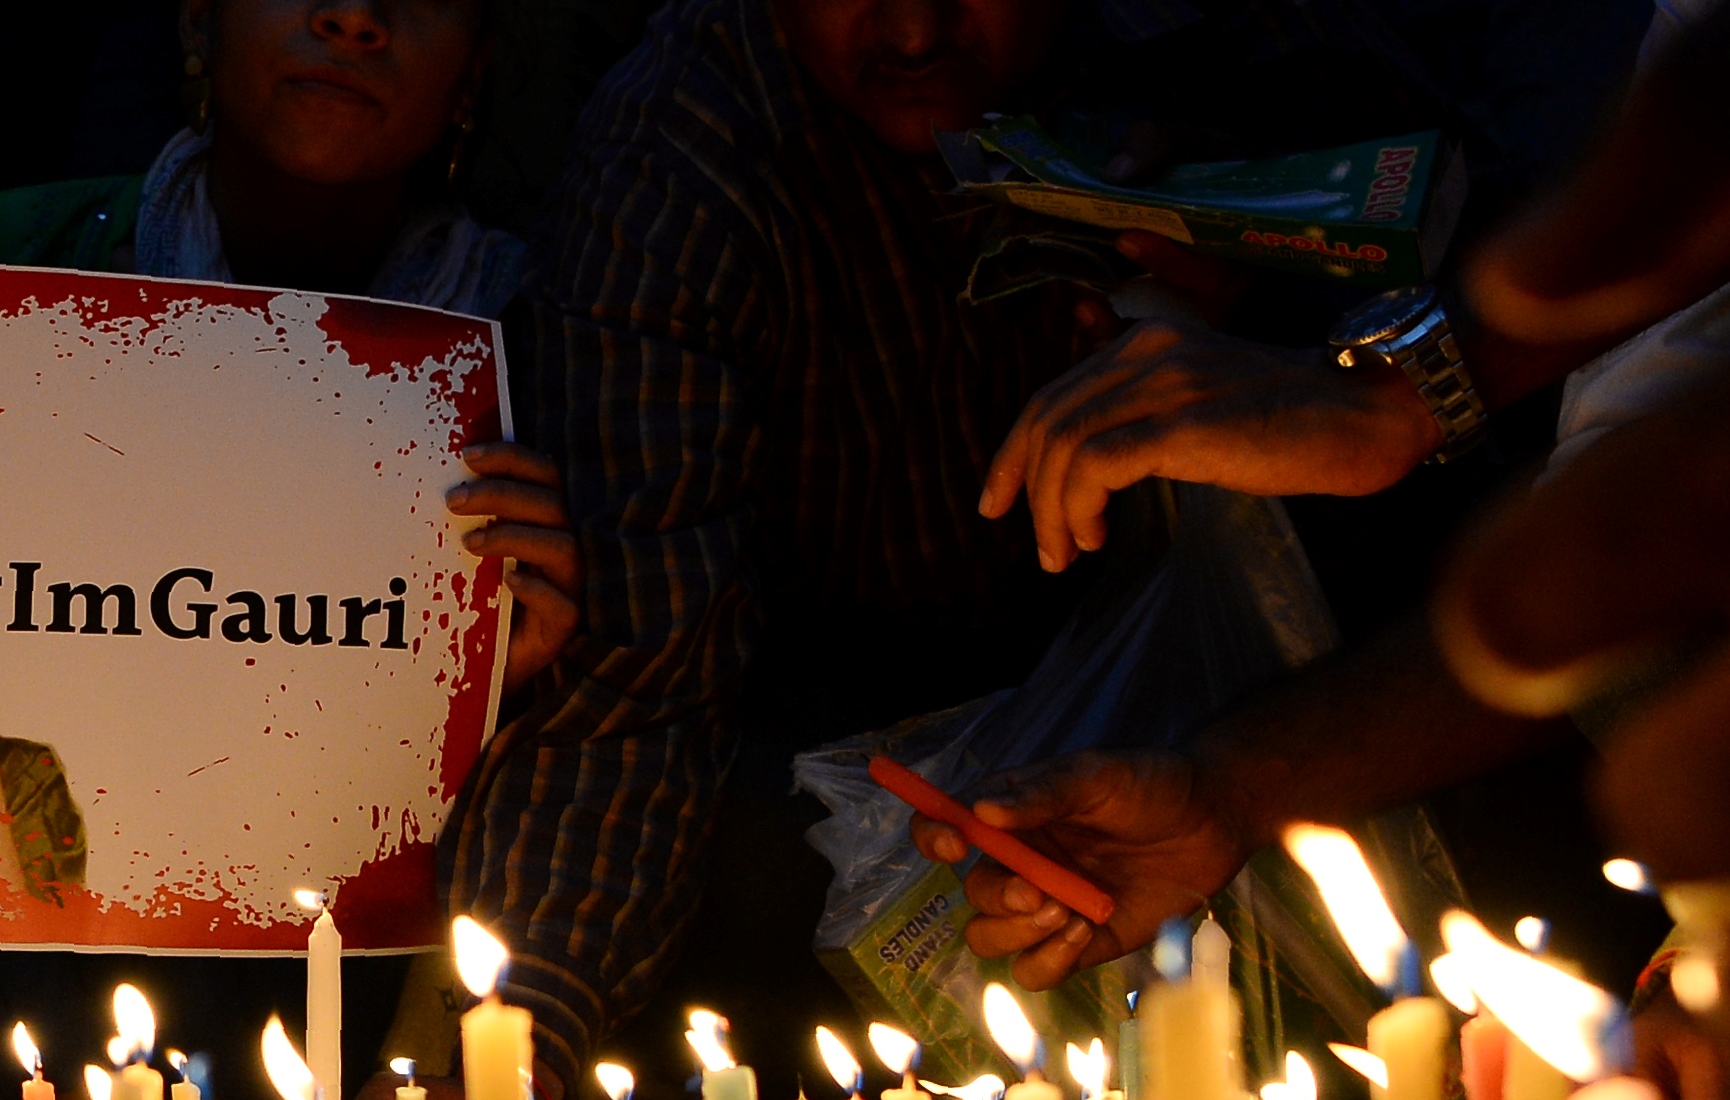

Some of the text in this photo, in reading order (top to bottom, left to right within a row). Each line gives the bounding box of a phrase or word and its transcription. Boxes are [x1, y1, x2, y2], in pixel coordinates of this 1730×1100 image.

[1359, 146, 1418, 222] APOLLO
[1241, 230, 1388, 261] APOLLO
[878, 893, 949, 964] CANDLES
[903, 920, 957, 972] STAND
